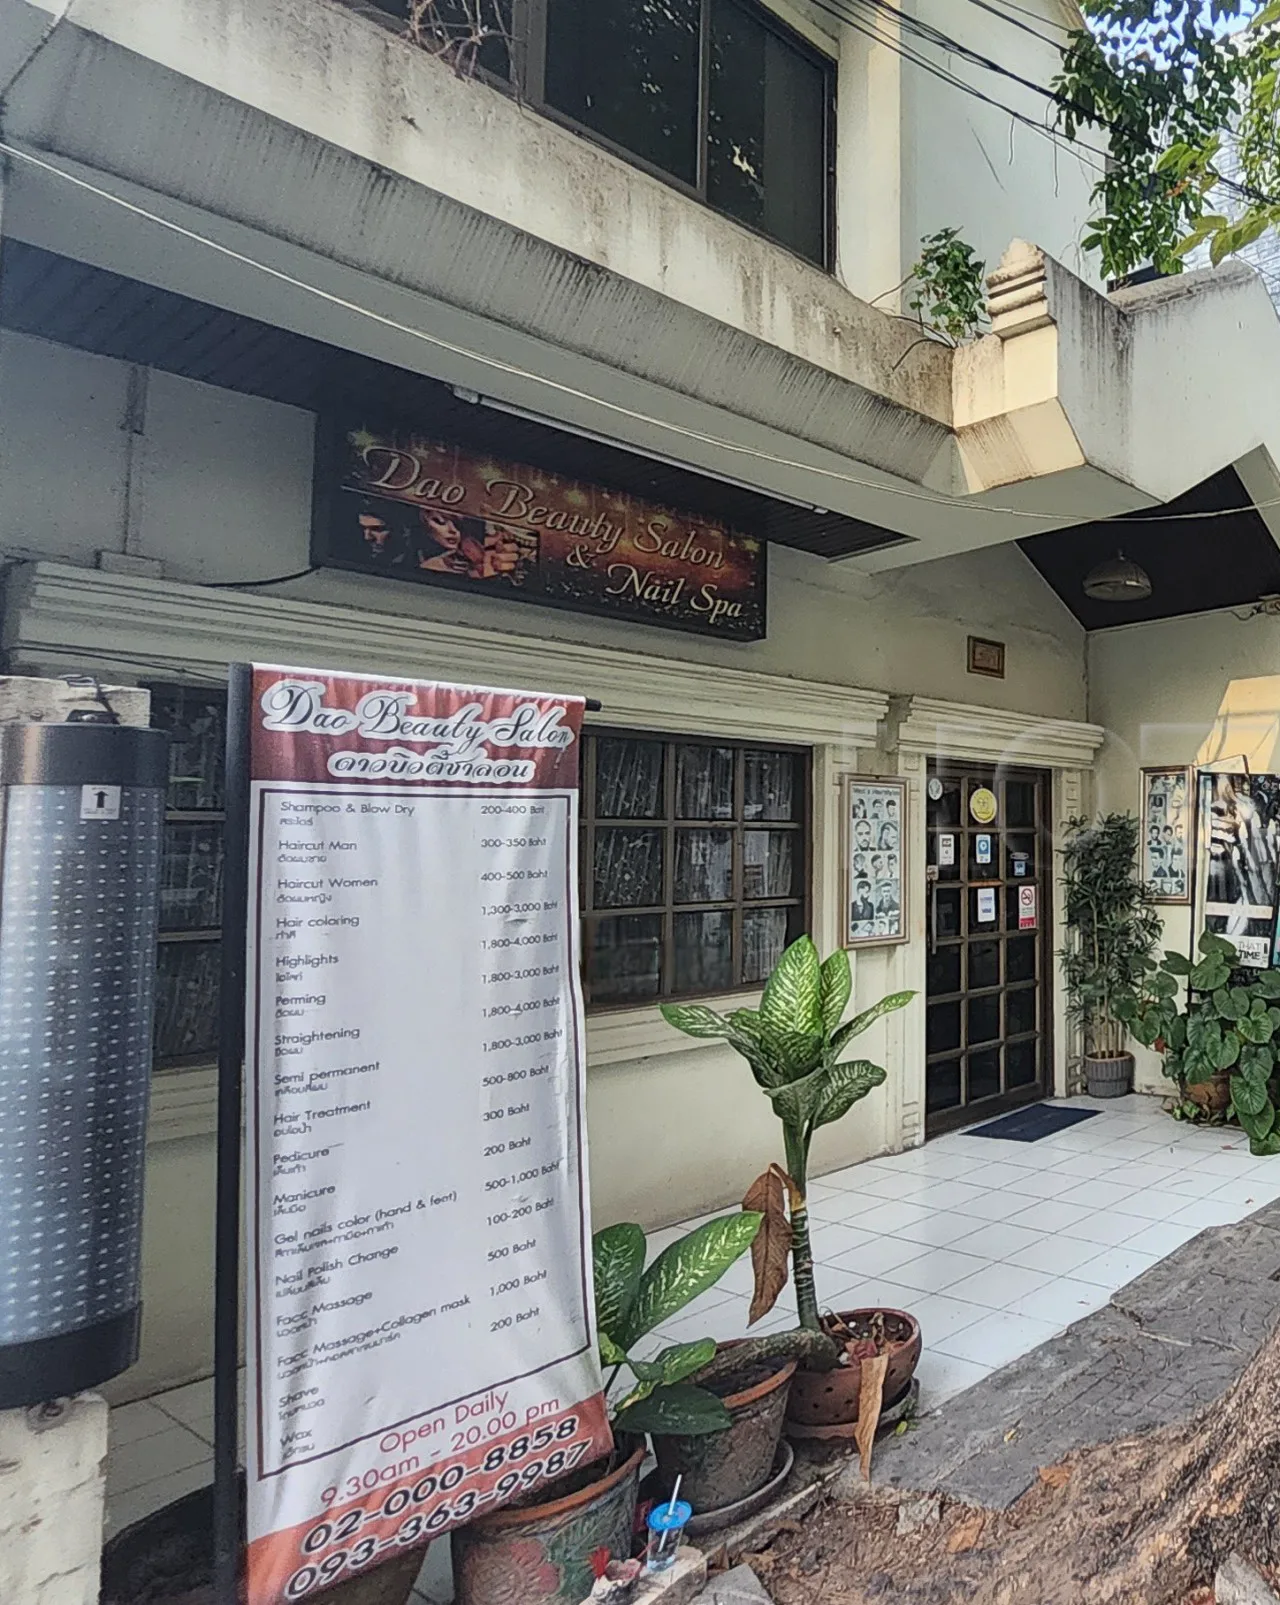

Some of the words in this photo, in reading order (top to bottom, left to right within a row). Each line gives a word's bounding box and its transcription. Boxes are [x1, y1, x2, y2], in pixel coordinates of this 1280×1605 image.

[363, 445, 466, 504] Dao
[486, 479, 625, 553] Beauty
[633, 521, 725, 569] Salon
[566, 544, 596, 569] &
[605, 563, 685, 605] Nail
[690, 583, 743, 624] Spa
[271, 685, 349, 729] Dao
[362, 696, 484, 754] Beauty
[491, 707, 570, 744] Salon
[281, 801, 341, 815] Shampoo
[345, 803, 356, 813] &
[360, 803, 390, 813] Blow
[394, 804, 415, 816] Dry
[480, 805, 527, 814] 200-400
[279, 840, 324, 850] Haircut
[328, 841, 357, 850] Man
[480, 838, 527, 847] 300-350
[277, 878, 323, 889] Haircut
[328, 877, 378, 888] Women
[480, 870, 525, 881] 400-500
[527, 869, 548, 879] Baht
[276, 917, 303, 928] Hair
[308, 915, 360, 928] coloring
[276, 953, 340, 968] Highlights
[1238, 949, 1260, 960] TIME
[275, 993, 326, 1007] Perming
[274, 1027, 361, 1046] Straightening
[544, 1029, 563, 1041] Baht
[274, 1071, 304, 1085] Semi
[309, 1061, 380, 1087] permanent
[482, 1069, 527, 1087] 500-800
[529, 1065, 549, 1077] Baht
[273, 1111, 301, 1125] Hair
[304, 1100, 371, 1121] Treatment
[483, 1108, 504, 1121] 300
[507, 1103, 530, 1116] Baht
[273, 1148, 330, 1164] Pedicure
[483, 1143, 505, 1157] 200
[508, 1137, 531, 1150] Baht
[273, 1185, 335, 1205] Manicure
[274, 1231, 298, 1245] Gel
[303, 1220, 333, 1239] nails
[337, 1215, 372, 1231] color
[375, 1201, 412, 1222] (hand
[416, 1198, 426, 1210] &
[486, 1205, 532, 1226] 100-200
[487, 1247, 509, 1262] 500
[512, 1239, 536, 1254] Baht
[275, 1269, 303, 1286] Nail
[307, 1259, 343, 1278] Polish
[348, 1246, 398, 1266] Change
[490, 1278, 520, 1297] 1,000
[523, 1269, 547, 1285] Baht
[276, 1310, 308, 1326] Face
[311, 1292, 372, 1315] Massage
[490, 1316, 512, 1332] 200
[516, 1307, 540, 1323] Baht
[277, 1349, 308, 1367] Face
[440, 1294, 471, 1313] mask
[279, 1387, 319, 1408] Shave
[379, 1416, 445, 1454] Open
[455, 1391, 509, 1424] Daily
[280, 1429, 312, 1446] Wax
[320, 1456, 420, 1508] 9.30am
[450, 1412, 517, 1452] 20.00
[525, 1398, 560, 1427] pm
[303, 1417, 577, 1554] 02-000-8858
[286, 1440, 592, 1598] 093-363-9987
